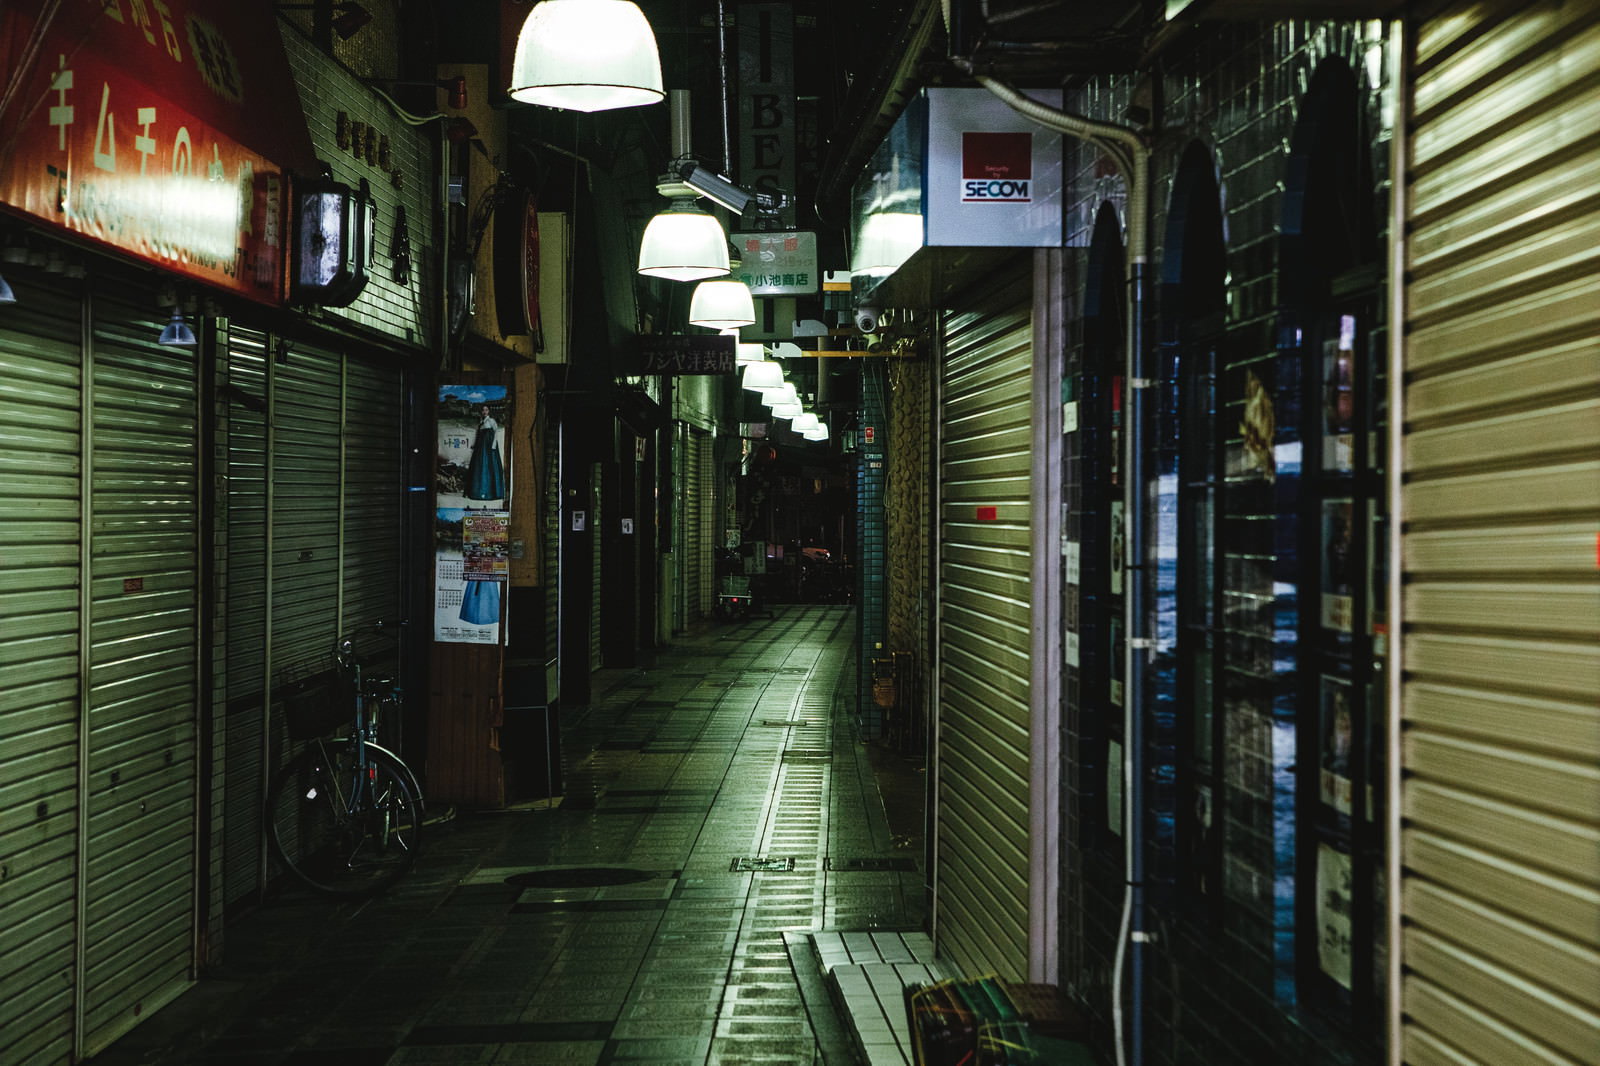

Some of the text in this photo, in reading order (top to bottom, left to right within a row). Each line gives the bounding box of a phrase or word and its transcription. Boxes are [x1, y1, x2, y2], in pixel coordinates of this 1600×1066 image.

[985, 165, 1010, 173] Security
[965, 181, 1028, 197] SECOM
[755, 273, 809, 287] 小池商店
[642, 350, 733, 371] フジヤ洋装店
